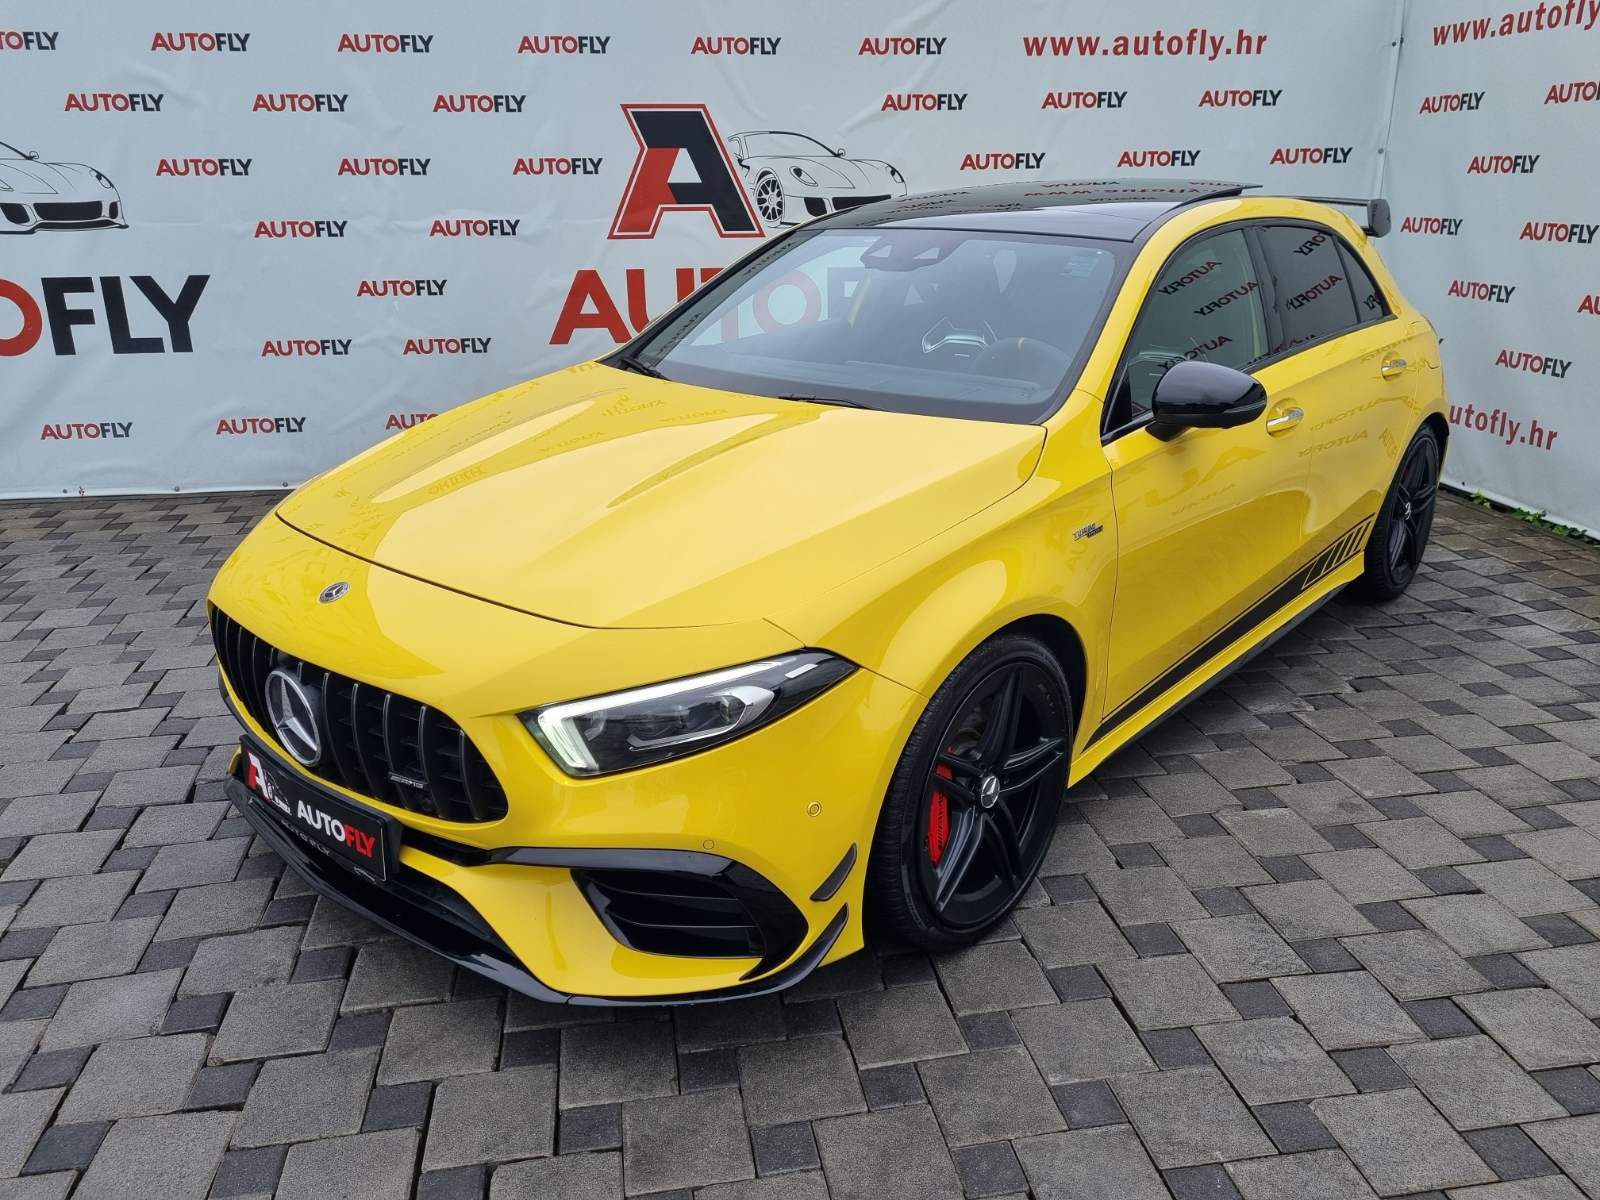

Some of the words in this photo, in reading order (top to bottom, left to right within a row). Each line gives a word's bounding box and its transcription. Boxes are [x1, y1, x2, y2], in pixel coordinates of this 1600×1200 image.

[151, 32, 250, 52] AUTOFLY
[337, 32, 433, 54] AUTOFLY
[517, 34, 611, 55] AUTOFLY
[690, 36, 781, 55] AUTOFLY
[858, 36, 947, 56] AUTOFLY
[1023, 28, 1267, 63] www.autofly.hr
[64, 92, 164, 112] AUTOFLY
[1041, 90, 1128, 110] AUTOFLY
[1198, 89, 1283, 108] AUTOFLY
[1544, 80, 1600, 104] AUTO
[252, 93, 349, 112] AUTOFLY
[433, 94, 526, 112] AUTOFLY
[880, 93, 968, 112] AUTOFLY
[1419, 91, 1485, 114] AUTOFLY
[513, 156, 603, 176] AUTOFLY
[960, 152, 1046, 171] AUTOFLY
[1116, 149, 1201, 168] AUTOFLY
[1268, 146, 1353, 166] AUTOFLY
[1467, 154, 1540, 175] AUTOFLY
[156, 157, 253, 176] AUTOFLY
[338, 157, 431, 176] AUTOFLY
[254, 219, 348, 239] AUTOFLY
[429, 216, 520, 238] AUTOFLY
[1400, 216, 1463, 236] AUTOFLY
[1520, 222, 1600, 244] AUTOFLY
[357, 278, 447, 297] AUTOFLY
[1448, 280, 1516, 303] AUTOFLY
[261, 338, 352, 358] AUTOFLY
[402, 337, 492, 356] AUTOFLY
[1495, 350, 1572, 378] AUTOFLY
[41, 422, 133, 440] AUTOFLY
[216, 417, 306, 436] AUTOFLY
[297, 799, 376, 858] AUTOFLY
